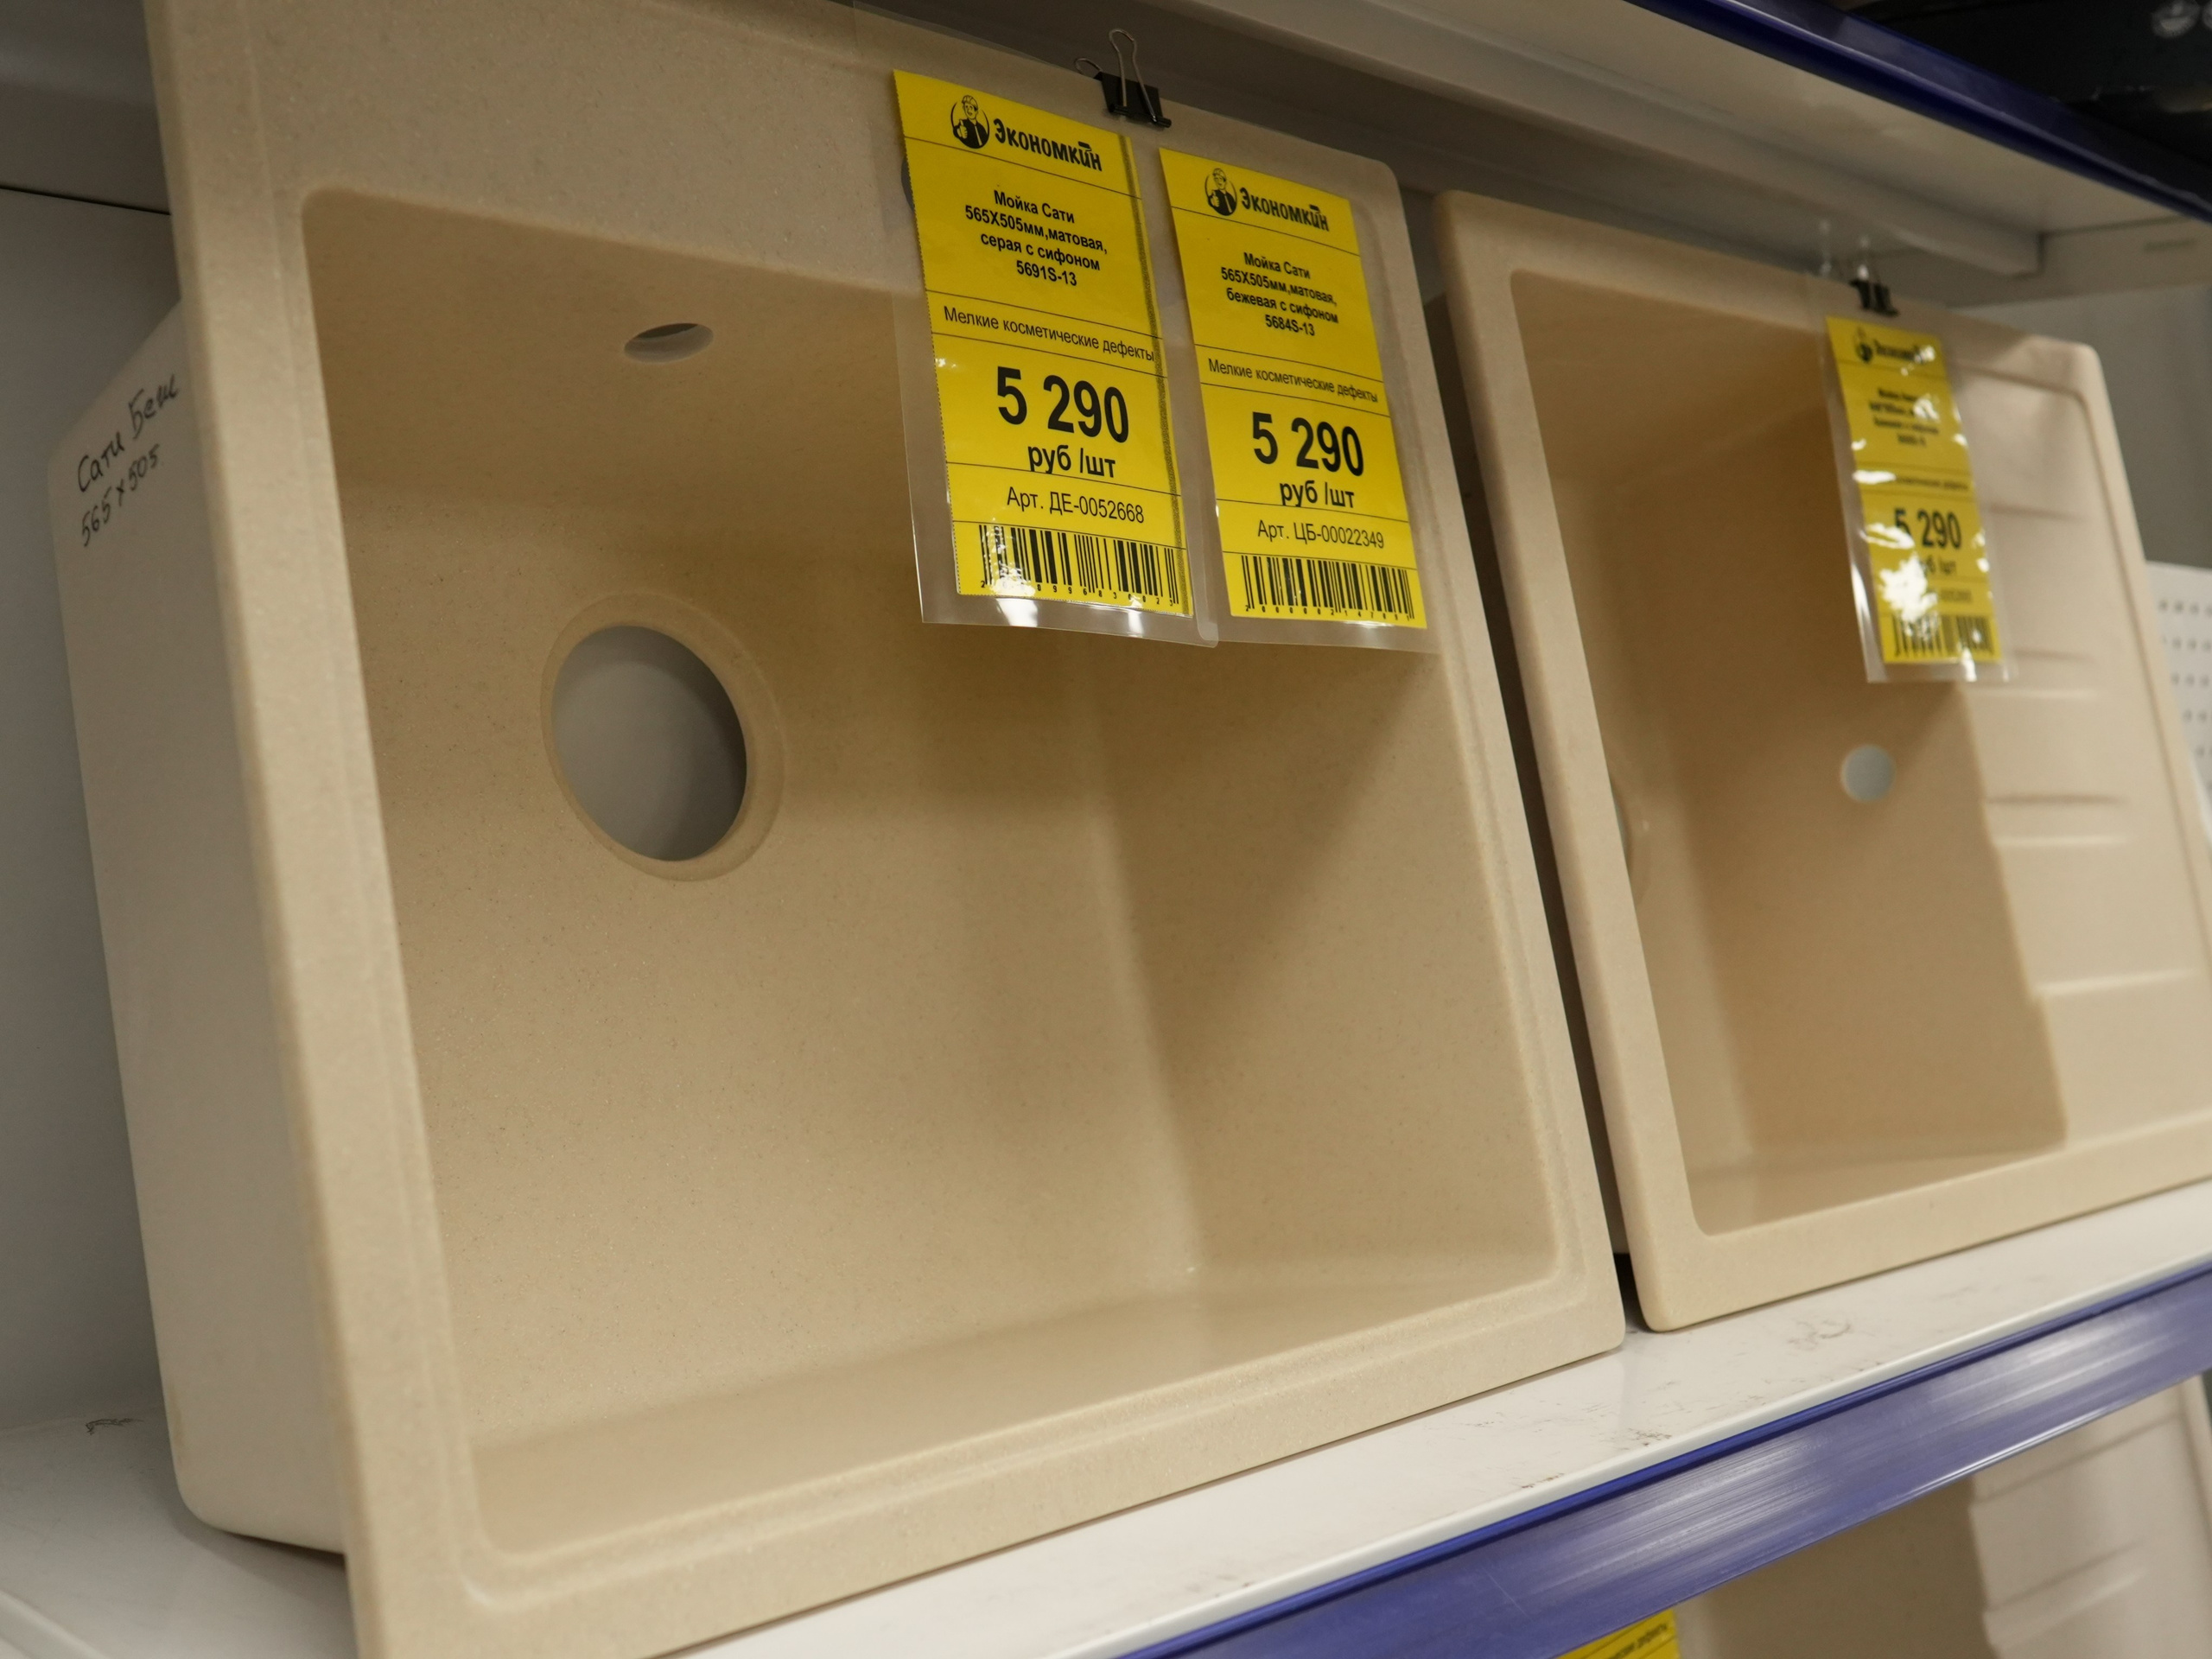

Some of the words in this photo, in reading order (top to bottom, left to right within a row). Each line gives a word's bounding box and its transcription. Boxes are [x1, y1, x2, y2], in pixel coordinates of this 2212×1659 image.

[994, 189, 1039, 215] Мойка
[1042, 203, 1075, 224] Сати
[981, 233, 1022, 253] серая
[1026, 244, 1034, 256] с
[1038, 246, 1100, 271] сифоном
[1244, 252, 1281, 273] Мойка
[1284, 262, 1311, 279] Сати
[1016, 260, 1077, 286] 5691S-13
[1227, 288, 1277, 310] бежевая
[1280, 301, 1287, 312] с
[1289, 304, 1338, 324] сифоном
[944, 305, 999, 329] Мелкие
[1003, 319, 1099, 349] косметические
[1103, 340, 1155, 362] дефекты
[1265, 315, 1315, 336] 5684S-13
[1208, 359, 1253, 378] Мелкие
[1255, 369, 1335, 392] косметические
[1338, 384, 1378, 403] дефекты
[997, 366, 1027, 426] 5
[1043, 375, 1129, 443] 290
[78, 431, 124, 493] Сати
[1027, 445, 1071, 474] руб
[1252, 411, 1279, 465] 5
[1291, 417, 1364, 477] 290
[1007, 486, 1044, 512] Арт.
[1049, 492, 1145, 524] ДЕ-0052668
[1280, 480, 1318, 507] руб
[1257, 520, 1289, 543] Арт.
[1293, 522, 1384, 550] ЦБ-00022349
[1917, 509, 1961, 550] 290
